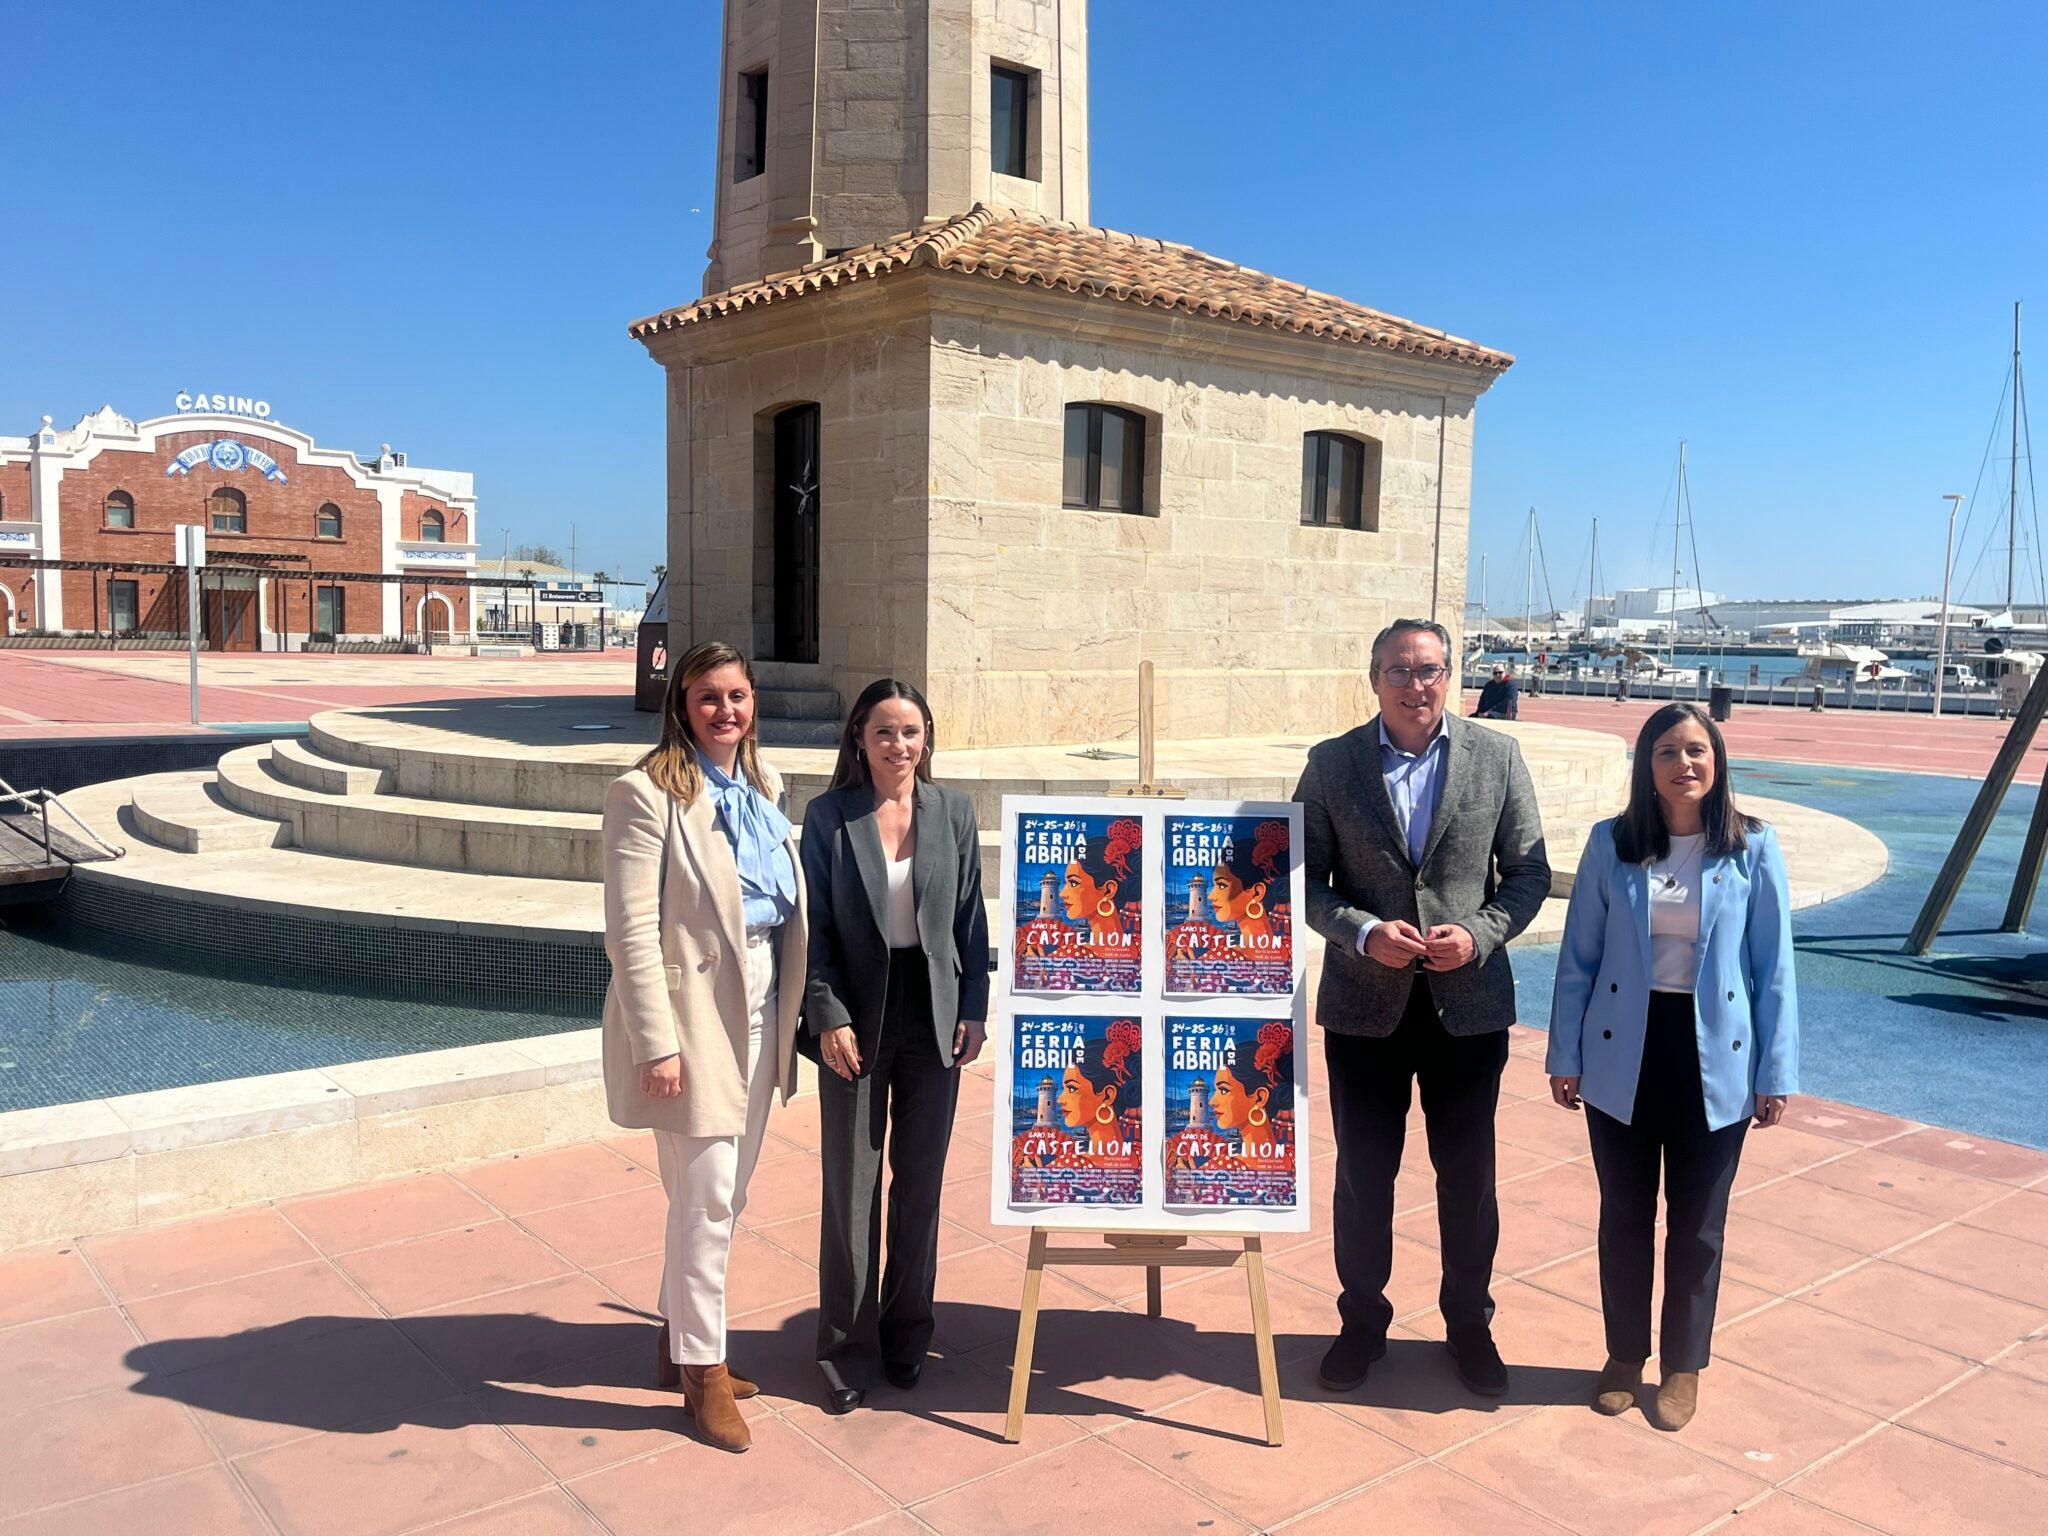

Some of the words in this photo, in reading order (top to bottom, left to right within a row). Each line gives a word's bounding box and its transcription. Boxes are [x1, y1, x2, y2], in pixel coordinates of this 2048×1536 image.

[176, 393, 271, 417] CASINO
[1025, 820, 1076, 831] 24-25-26
[1171, 822, 1222, 832] 24-25-26
[1025, 831, 1087, 846] FERIA
[1172, 834, 1234, 848] FERIA
[1025, 845, 1078, 865] ABRIL
[1078, 846, 1086, 860] DE
[1172, 847, 1225, 866] ABRIL
[1225, 848, 1234, 862] DE
[1021, 1022, 1073, 1033] 24-25-26
[1172, 1023, 1224, 1034] 24-25-26
[1021, 1034, 1085, 1049] FERIA
[1173, 1036, 1237, 1050] FERIA
[1021, 1048, 1076, 1069] ABRIL
[1076, 1049, 1085, 1064] DE
[1172, 1050, 1227, 1071] ABRIL
[1227, 1051, 1236, 1066] DE
